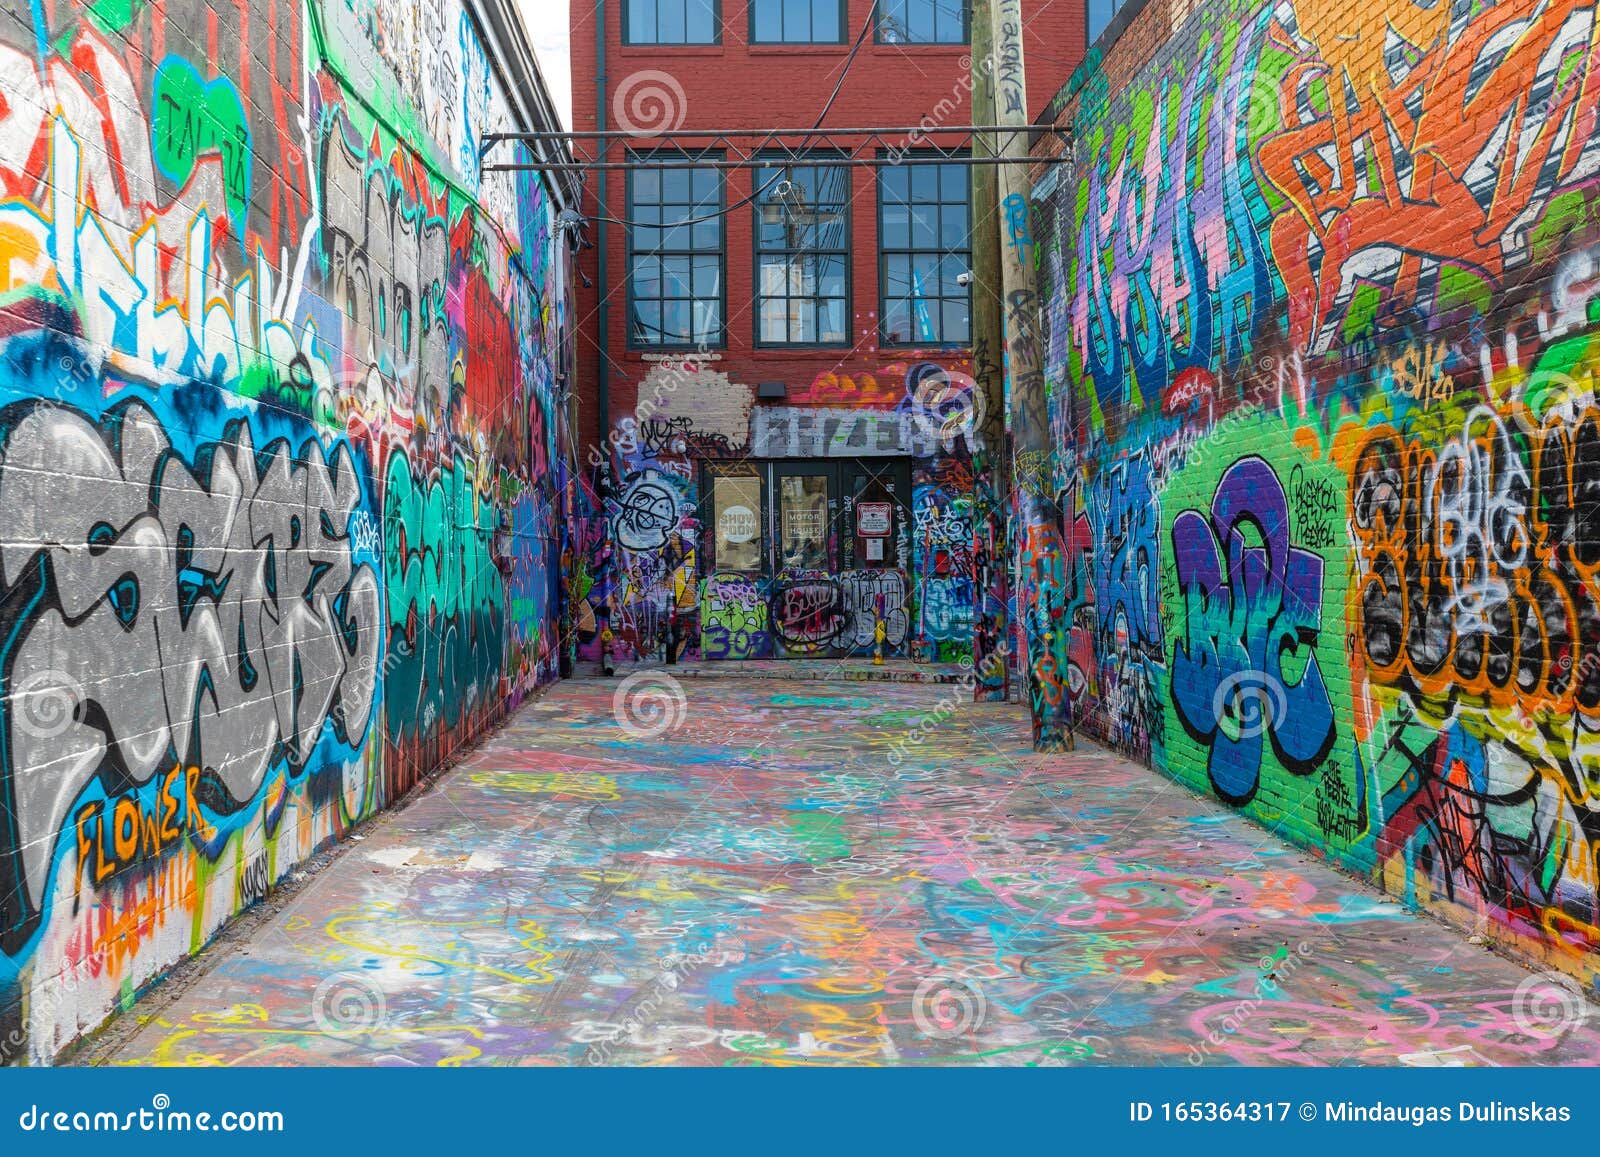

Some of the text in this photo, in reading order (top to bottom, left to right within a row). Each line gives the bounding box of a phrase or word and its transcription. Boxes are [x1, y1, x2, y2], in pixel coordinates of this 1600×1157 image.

[788, 513, 820, 522] MOTOR
[789, 526, 820, 536] HOUSE
[76, 762, 206, 895] FLOWER
